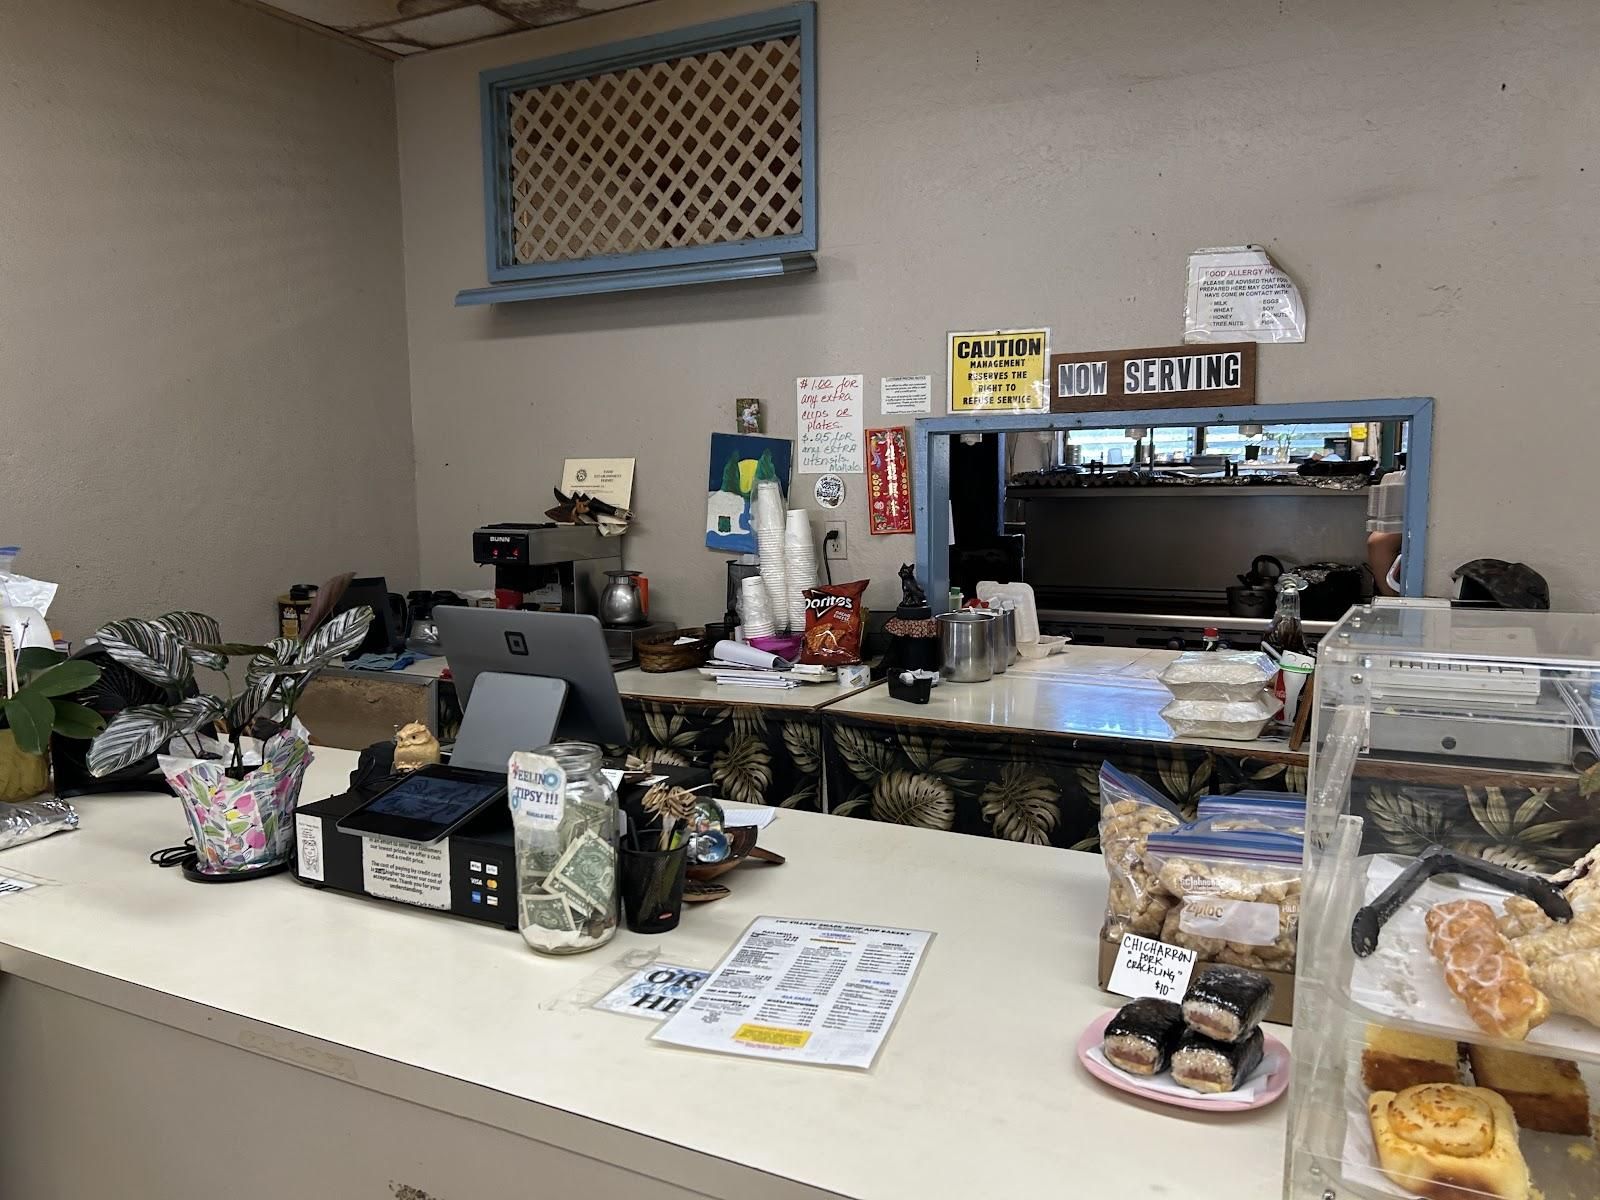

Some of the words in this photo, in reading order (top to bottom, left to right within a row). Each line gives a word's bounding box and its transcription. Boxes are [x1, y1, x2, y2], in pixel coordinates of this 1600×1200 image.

[1227, 268, 1263, 277] ALLERGY
[1265, 267, 1277, 275] NO
[1203, 279, 1225, 287] PLEASE
[1235, 278, 1260, 286] ADVISED
[957, 338, 1041, 359] CAUTION
[970, 359, 1026, 369] MANAGEMENT
[967, 371, 1008, 381] RESERVES
[1011, 370, 1028, 379] THE
[1059, 362, 1107, 396] NOW
[1125, 353, 1240, 393] SERVING
[978, 384, 1003, 393] RIGHT
[1006, 383, 1017, 392] TO
[801, 394, 818, 409] any
[962, 396, 994, 405] REFUSE
[997, 395, 1031, 404] SERVICE
[802, 410, 829, 420] cups
[801, 446, 819, 457] any
[513, 769, 547, 786] FEELIN
[515, 786, 543, 803] TIPSY
[399, 854, 412, 862] credit
[395, 865, 411, 873] paying
[417, 869, 430, 877] credit
[398, 877, 413, 886] Thank
[1185, 901, 1224, 918] Ziploc
[880, 929, 912, 937] BAKERY
[1123, 936, 1193, 963] CHICHARRON
